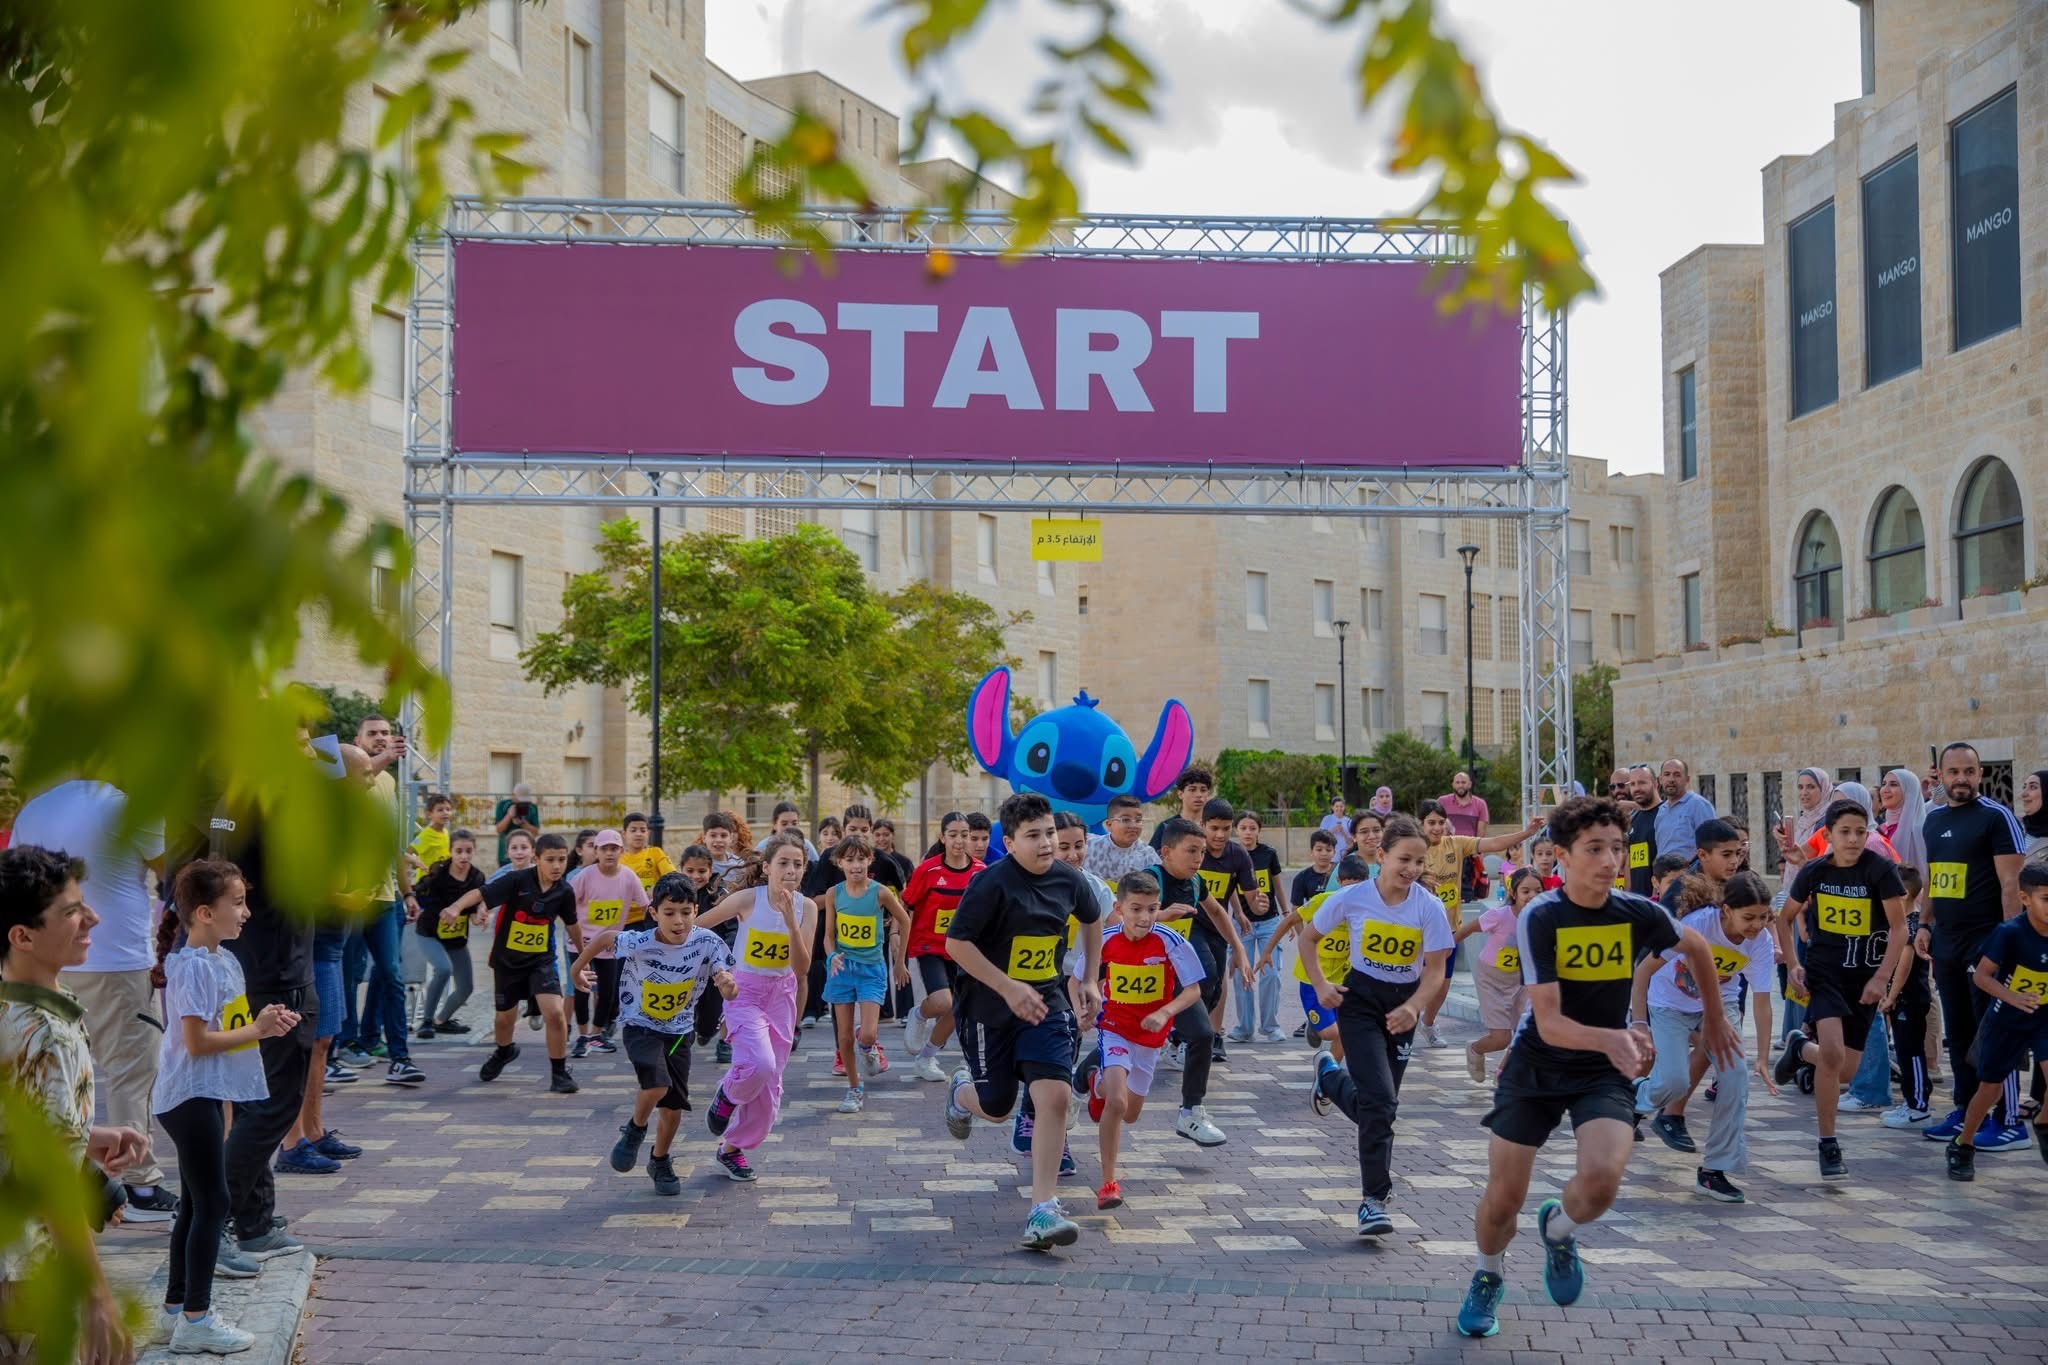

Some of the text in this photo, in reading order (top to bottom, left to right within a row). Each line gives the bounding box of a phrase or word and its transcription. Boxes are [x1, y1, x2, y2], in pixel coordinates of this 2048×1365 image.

[1967, 207, 2012, 243] MANGO
[1878, 256, 1917, 288] MANGO
[1801, 300, 1833, 328] MANGO
[731, 298, 1260, 413] START
[1037, 536, 1045, 545] م
[1046, 534, 1061, 544] 3.5
[1631, 852, 1645, 861] 415
[1932, 873, 1957, 889] 401
[1437, 889, 1455, 902] 23
[595, 907, 618, 921] 217
[1825, 906, 1862, 927] 213
[513, 931, 545, 945] 226
[841, 923, 871, 939] 028
[750, 941, 790, 960] 243
[1366, 933, 1416, 957] 208
[1565, 941, 1624, 968] 204
[648, 959, 693, 974] Ready
[1017, 949, 1054, 970] 222
[1363, 957, 1412, 973] adidas
[1116, 976, 1157, 995] 242
[2017, 978, 2048, 997] 23
[648, 991, 688, 1011] 238
